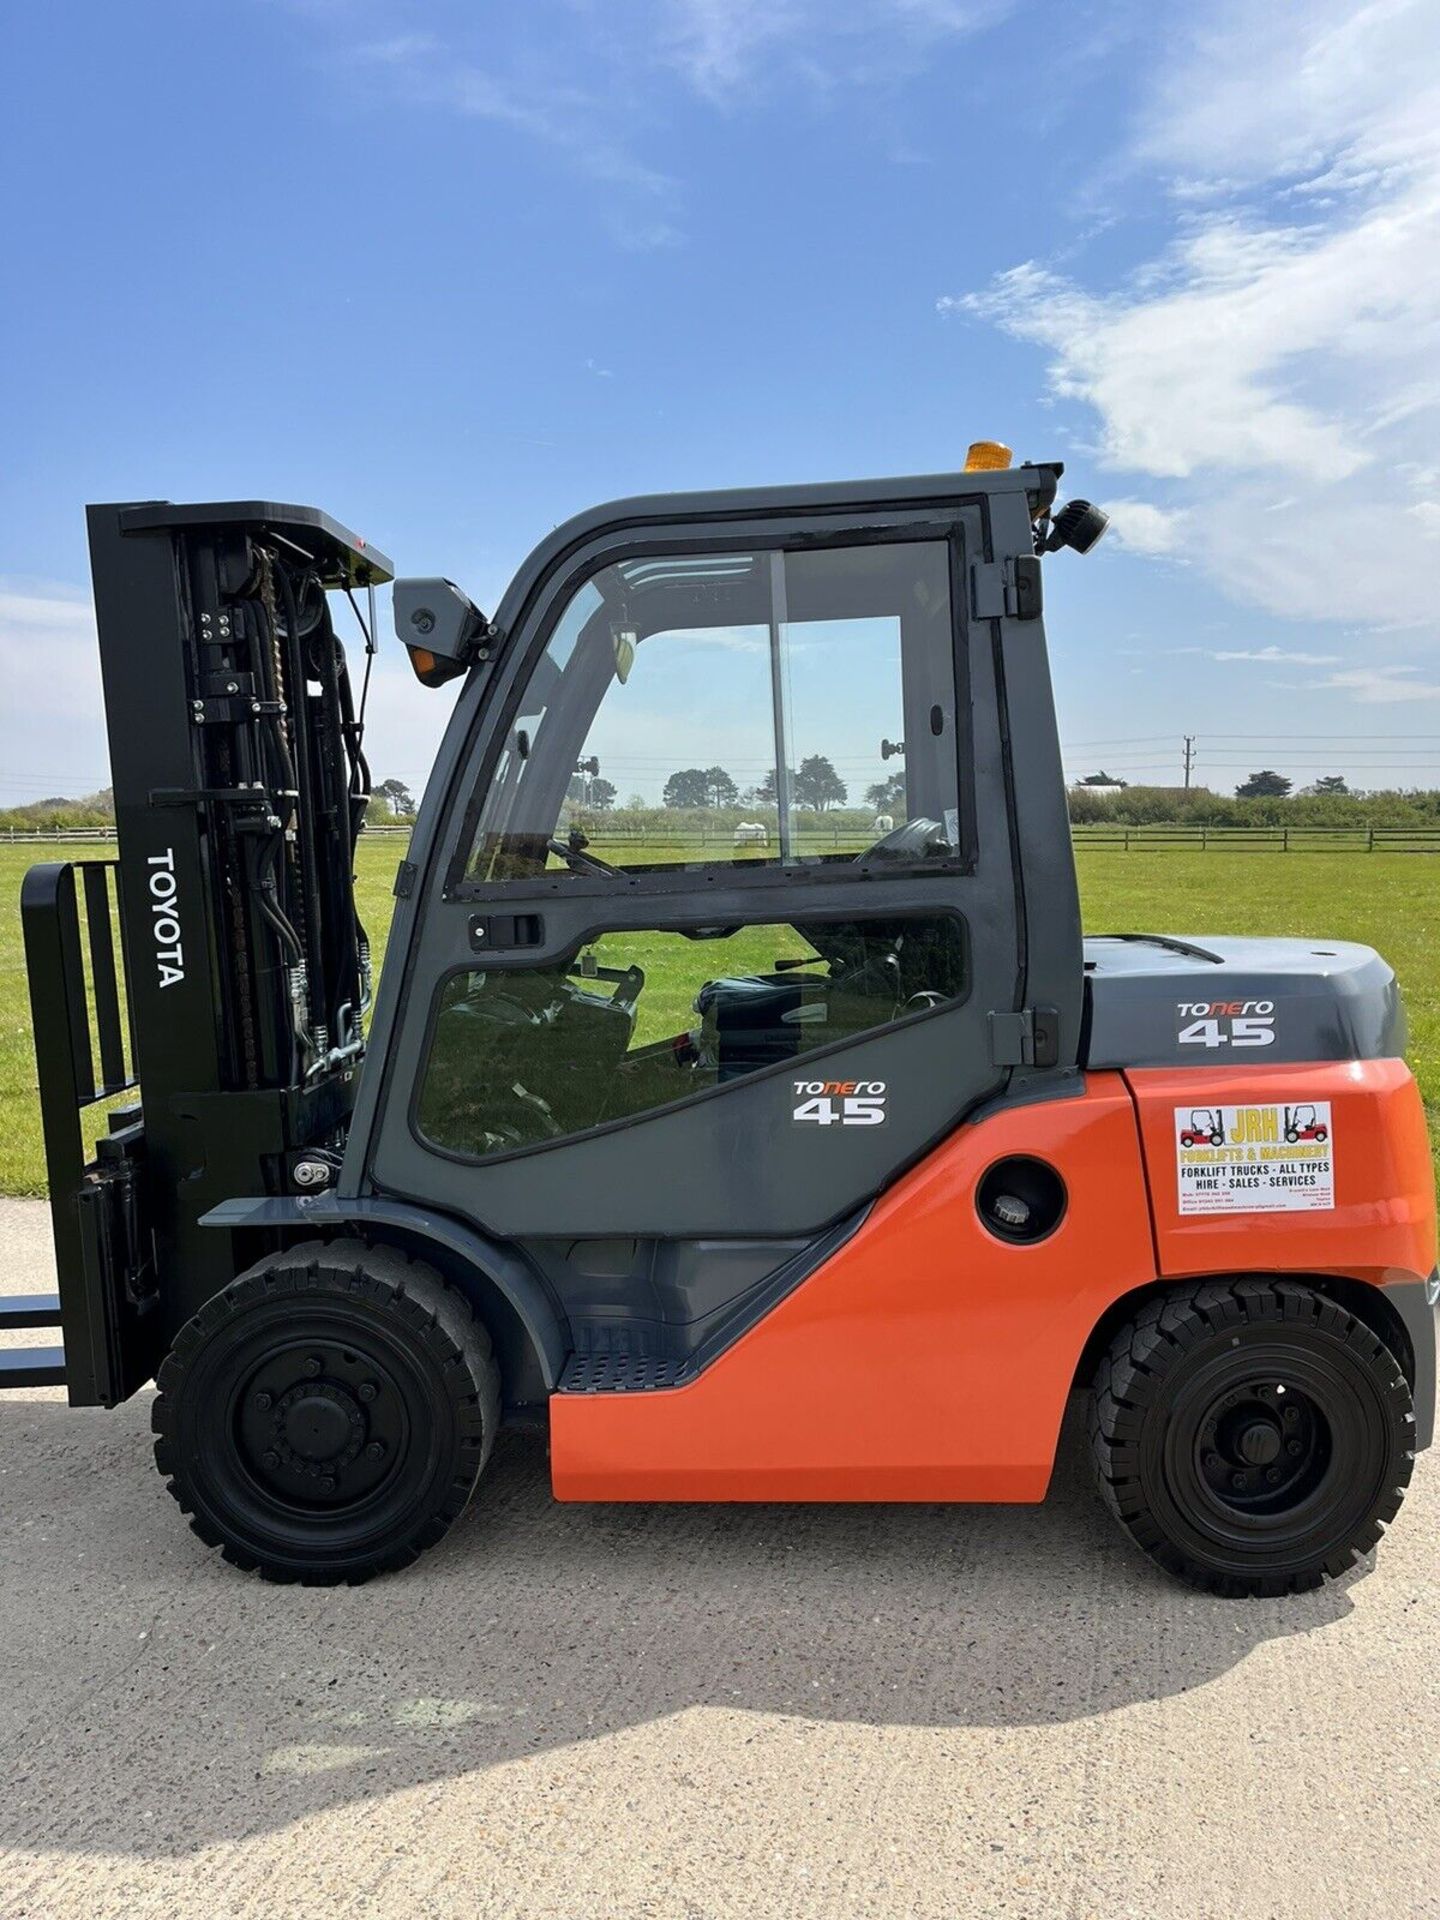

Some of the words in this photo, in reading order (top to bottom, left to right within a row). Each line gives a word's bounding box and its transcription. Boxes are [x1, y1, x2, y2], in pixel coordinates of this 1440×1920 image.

[147, 848, 185, 989] TOYOTA
[1178, 1017, 1275, 1048] 45
[793, 1097, 886, 1126] 45
[1230, 1108, 1279, 1144] JRH
[1180, 1147, 1244, 1163] FORKLIFTS
[1247, 1146, 1257, 1161] &
[1260, 1144, 1329, 1160] MACHINERY
[1181, 1166, 1226, 1178] FORKLIFT
[1231, 1165, 1270, 1177] TRUCKS
[1279, 1163, 1297, 1174] ALL
[1300, 1162, 1330, 1173] TYPES
[1196, 1179, 1219, 1190] HIRE
[1228, 1177, 1260, 1189] SALES
[1269, 1175, 1316, 1187] SERVICES
